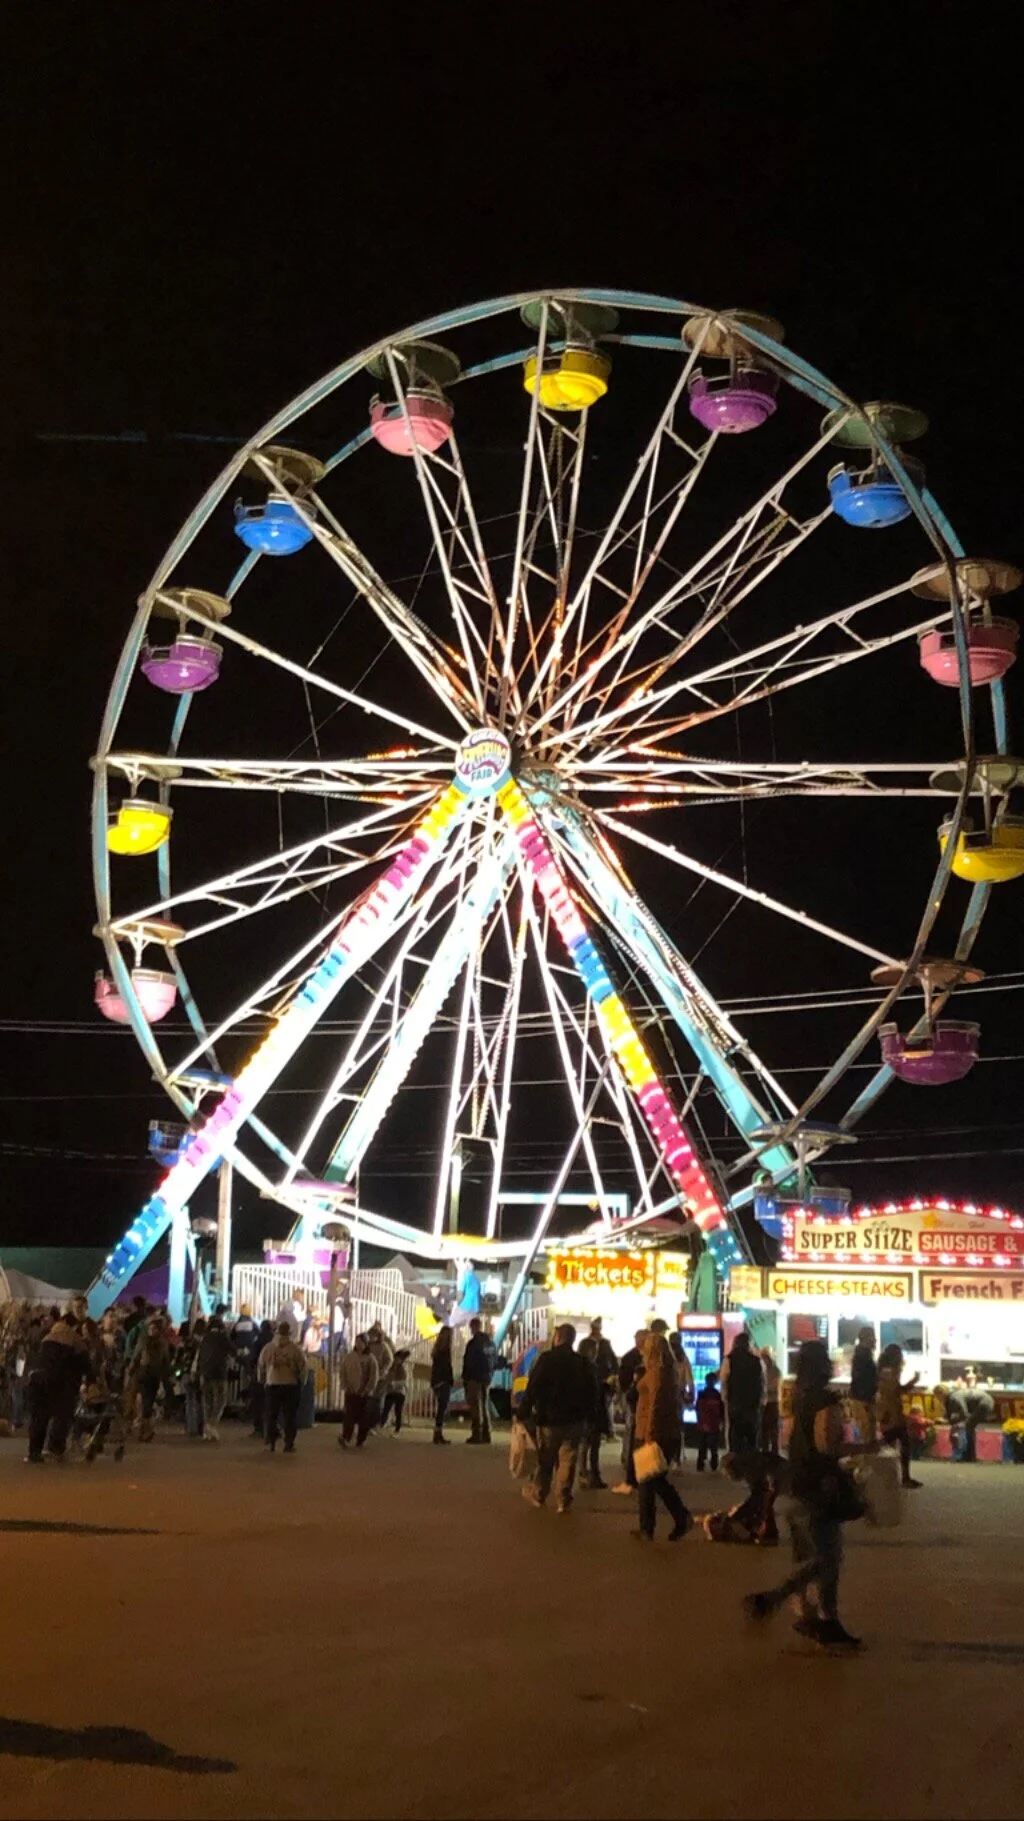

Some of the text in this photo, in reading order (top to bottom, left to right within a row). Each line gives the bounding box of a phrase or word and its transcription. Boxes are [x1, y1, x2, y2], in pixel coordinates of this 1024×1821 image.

[471, 768, 493, 782] FAIR
[801, 1230, 857, 1249] SUPER
[921, 1234, 1019, 1253] SAUSAGE &
[561, 1260, 644, 1284] Tickets
[773, 1278, 835, 1295] CHEESE
[840, 1280, 905, 1297] STEAKS
[930, 1279, 1003, 1298] French
